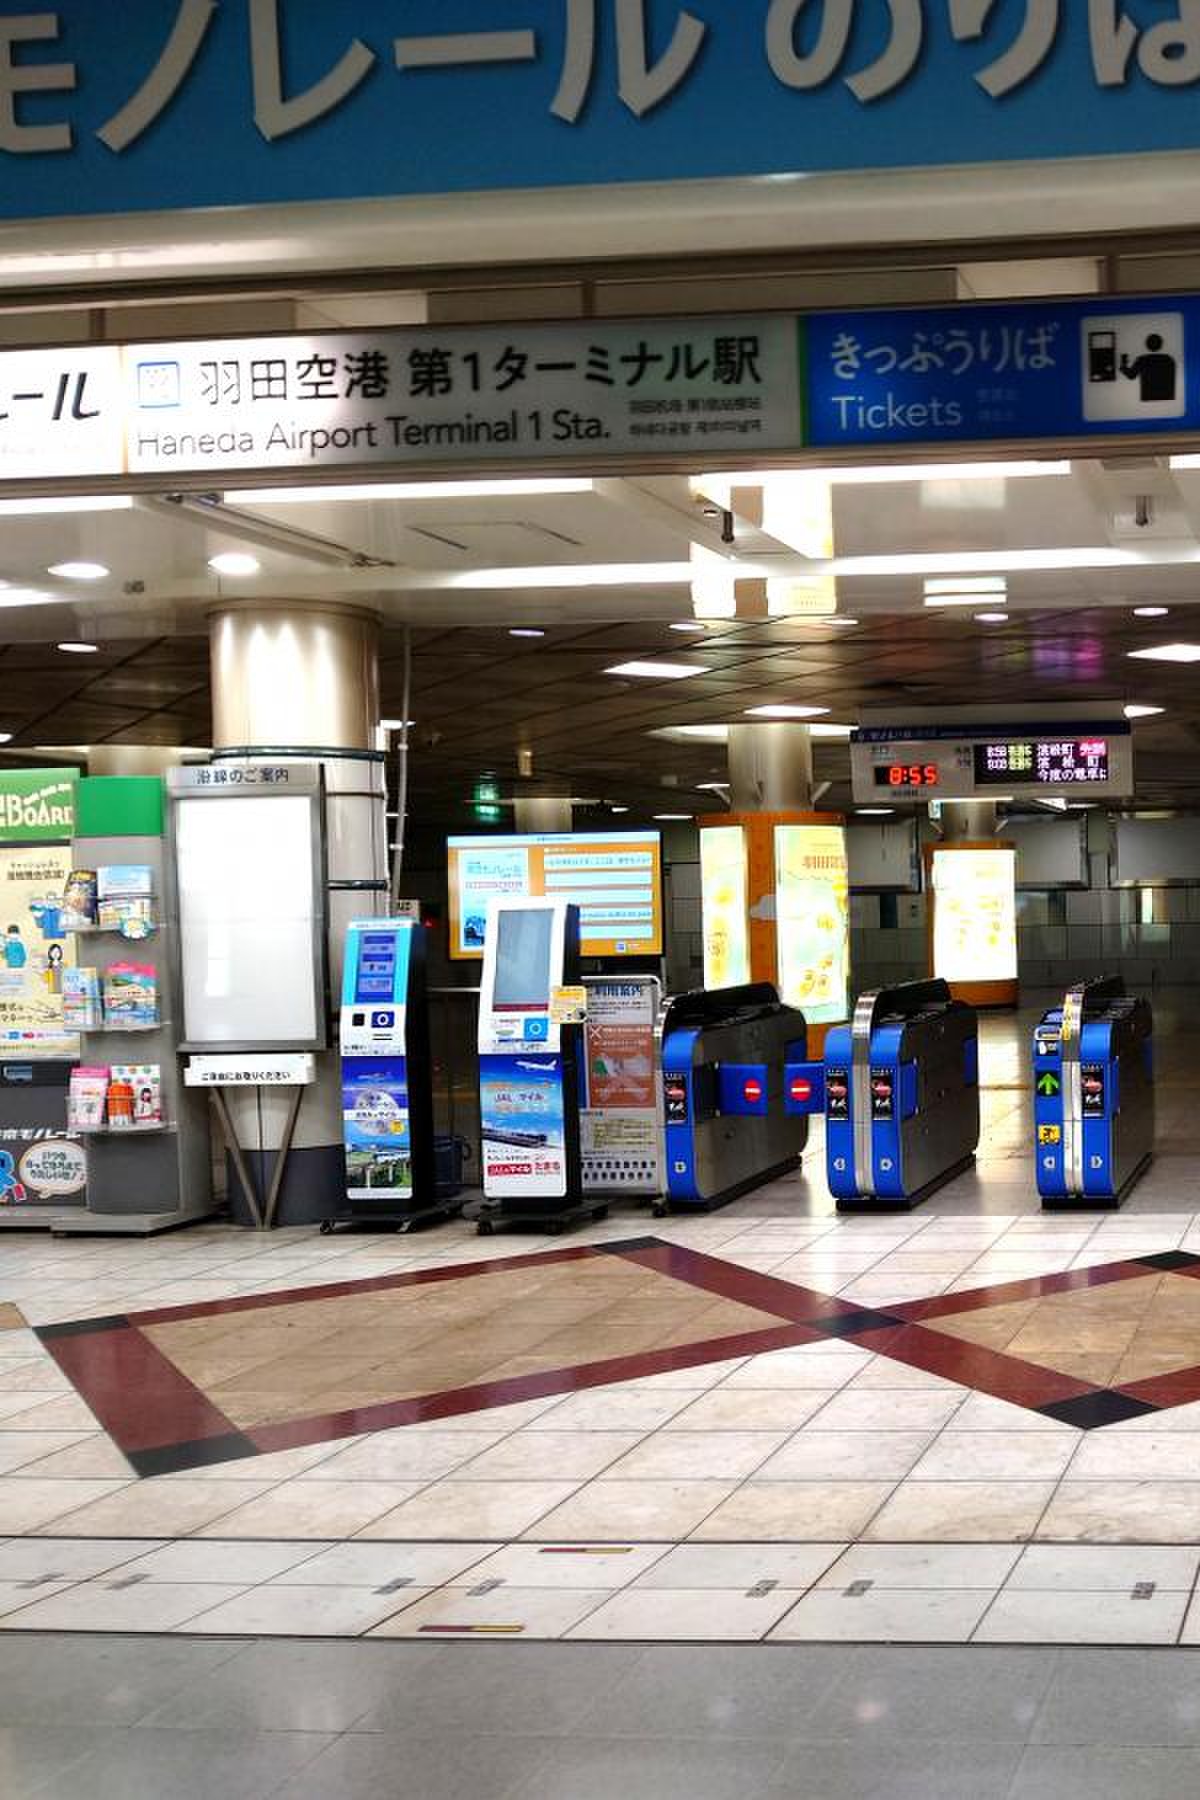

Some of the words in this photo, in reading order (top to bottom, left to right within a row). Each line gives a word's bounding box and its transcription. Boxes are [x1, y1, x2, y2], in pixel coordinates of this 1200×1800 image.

[199, 351, 392, 406] 羽田空港
[408, 334, 763, 398] 第1ターミナル駅
[830, 320, 1061, 380] きっぷうりば
[0, 372, 101, 421] ール
[830, 392, 962, 431] Tickets
[136, 429, 255, 459] Haneda
[266, 416, 377, 458] Airport
[385, 409, 520, 446] Terminal
[529, 411, 541, 442] 1
[554, 406, 611, 440] Sta.
[196, 767, 290, 784] 沿線のご案内
[889, 767, 937, 785] 8:55
